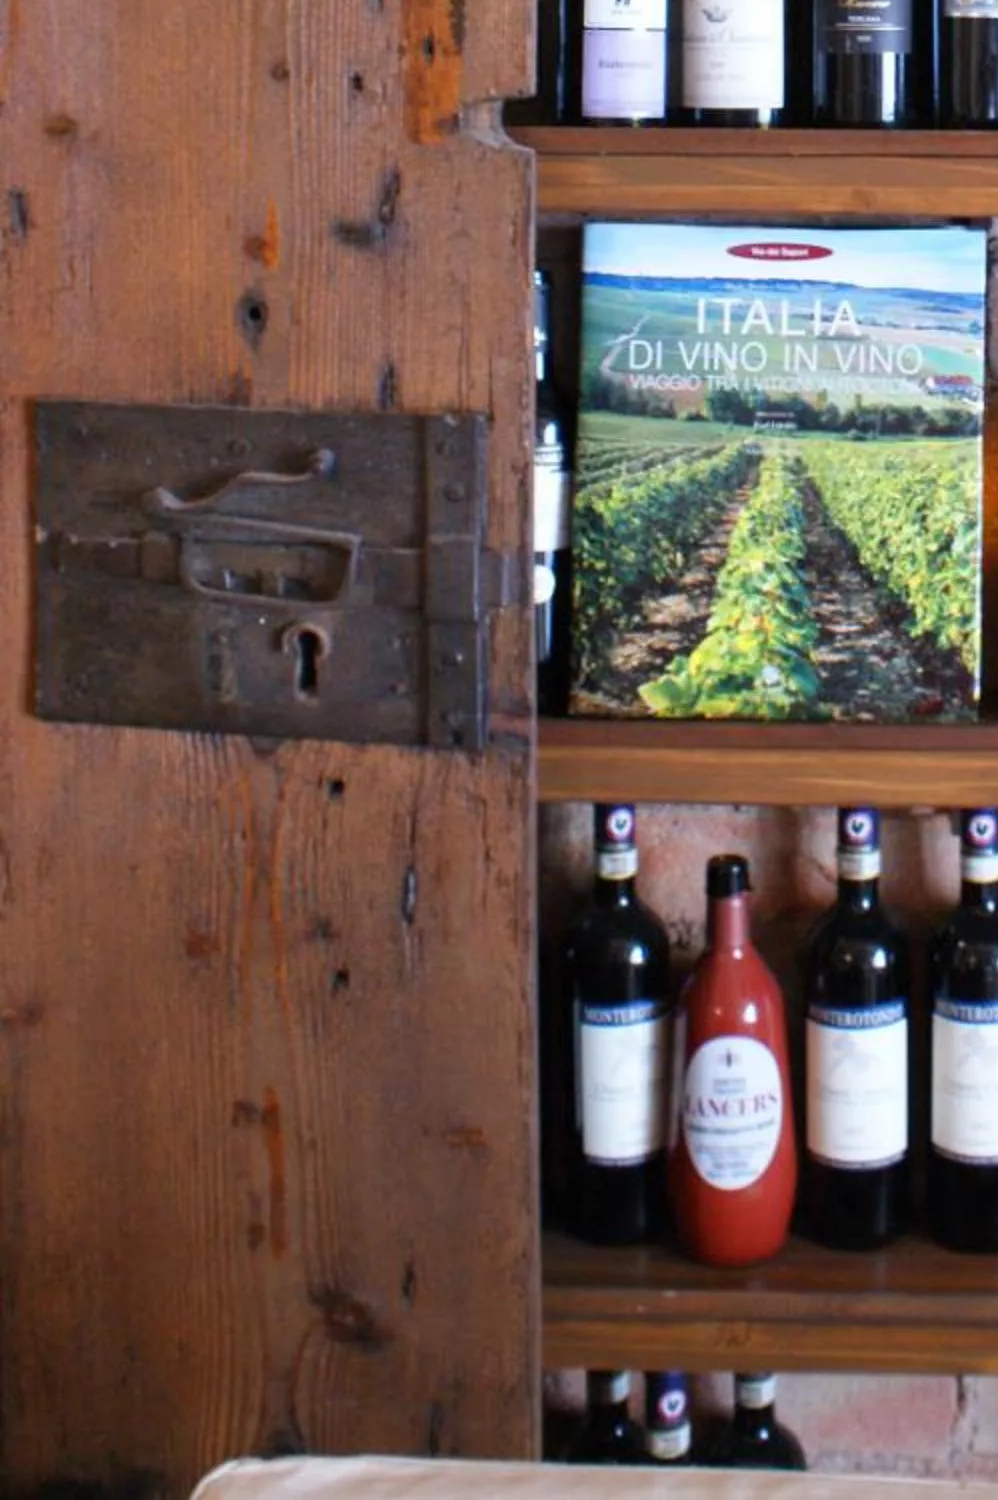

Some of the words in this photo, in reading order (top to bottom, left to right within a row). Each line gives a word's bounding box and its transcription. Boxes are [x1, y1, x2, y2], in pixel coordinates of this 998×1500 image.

[697, 298, 862, 336] ITALIA
[629, 339, 663, 370] DI
[678, 340, 768, 372] VINO
[784, 343, 818, 372] IN
[834, 344, 924, 376] VINO
